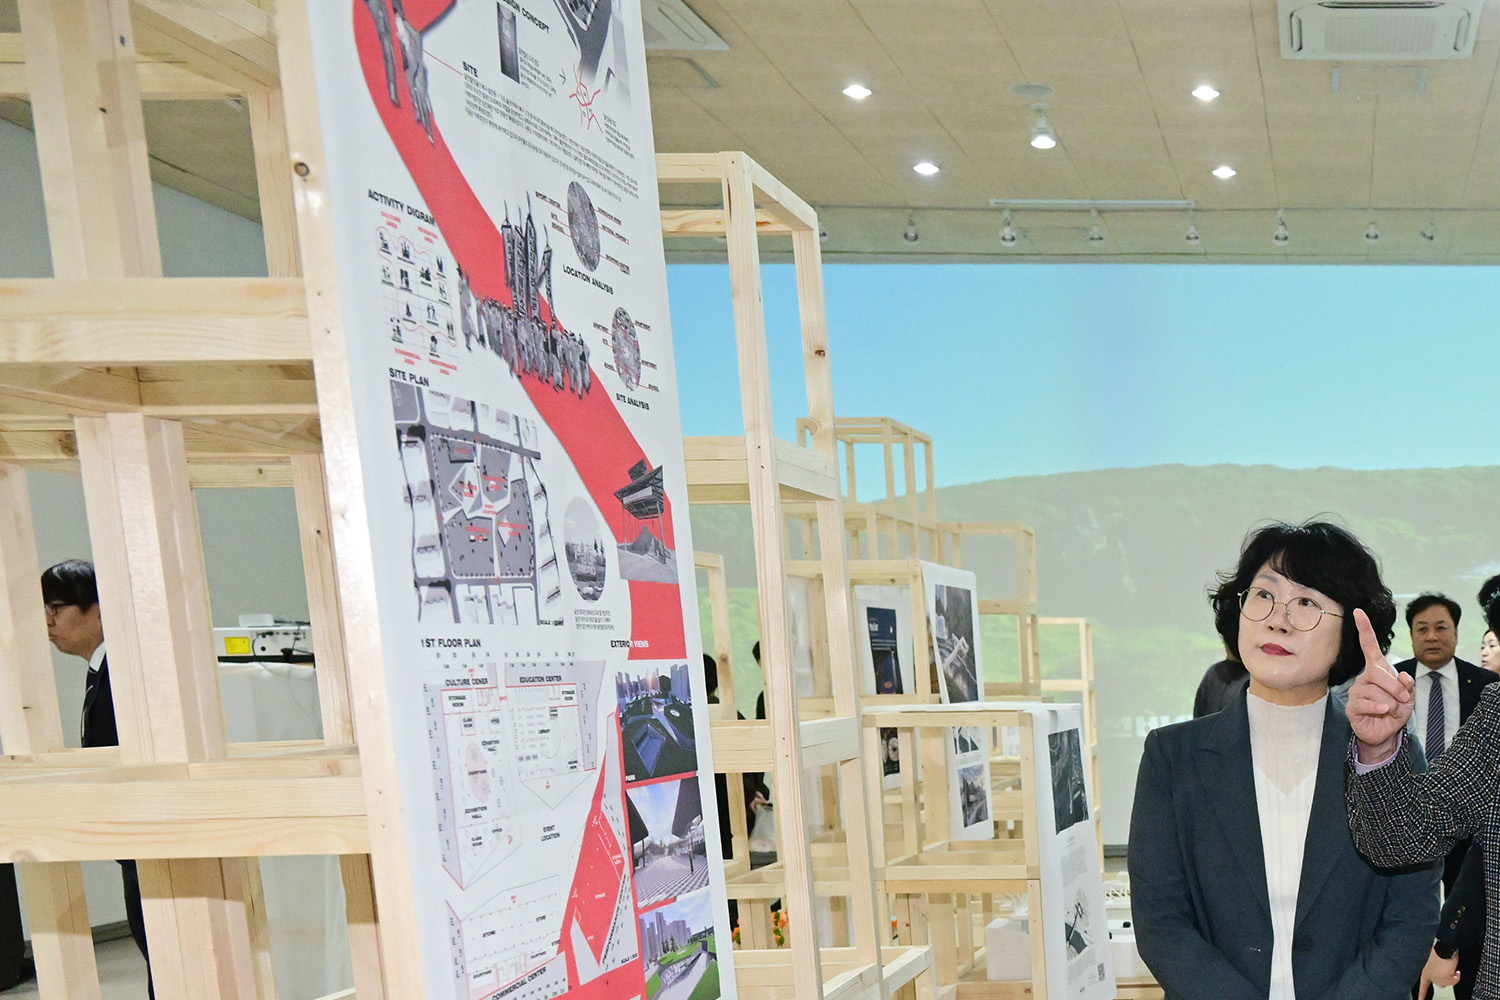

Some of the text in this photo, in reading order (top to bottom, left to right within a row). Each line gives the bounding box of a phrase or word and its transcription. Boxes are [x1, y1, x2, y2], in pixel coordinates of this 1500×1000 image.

[522, 7, 549, 34] CONCEPT
[462, 61, 478, 78] SITE
[368, 188, 436, 227] ACTIVITY DIGRAM
[563, 264, 614, 295] LOCATION ANALYSIS
[389, 367, 430, 387] SITE PLAN
[616, 392, 650, 411] SITE ANALYSIS
[438, 639, 462, 647] FLOOR
[464, 639, 481, 648] PLAN
[611, 640, 649, 648] EXTERIOR VIEWS
[445, 679, 470, 687] CULTURE
[541, 832, 560, 842] LOCATION
[527, 966, 547, 983] CENTER
